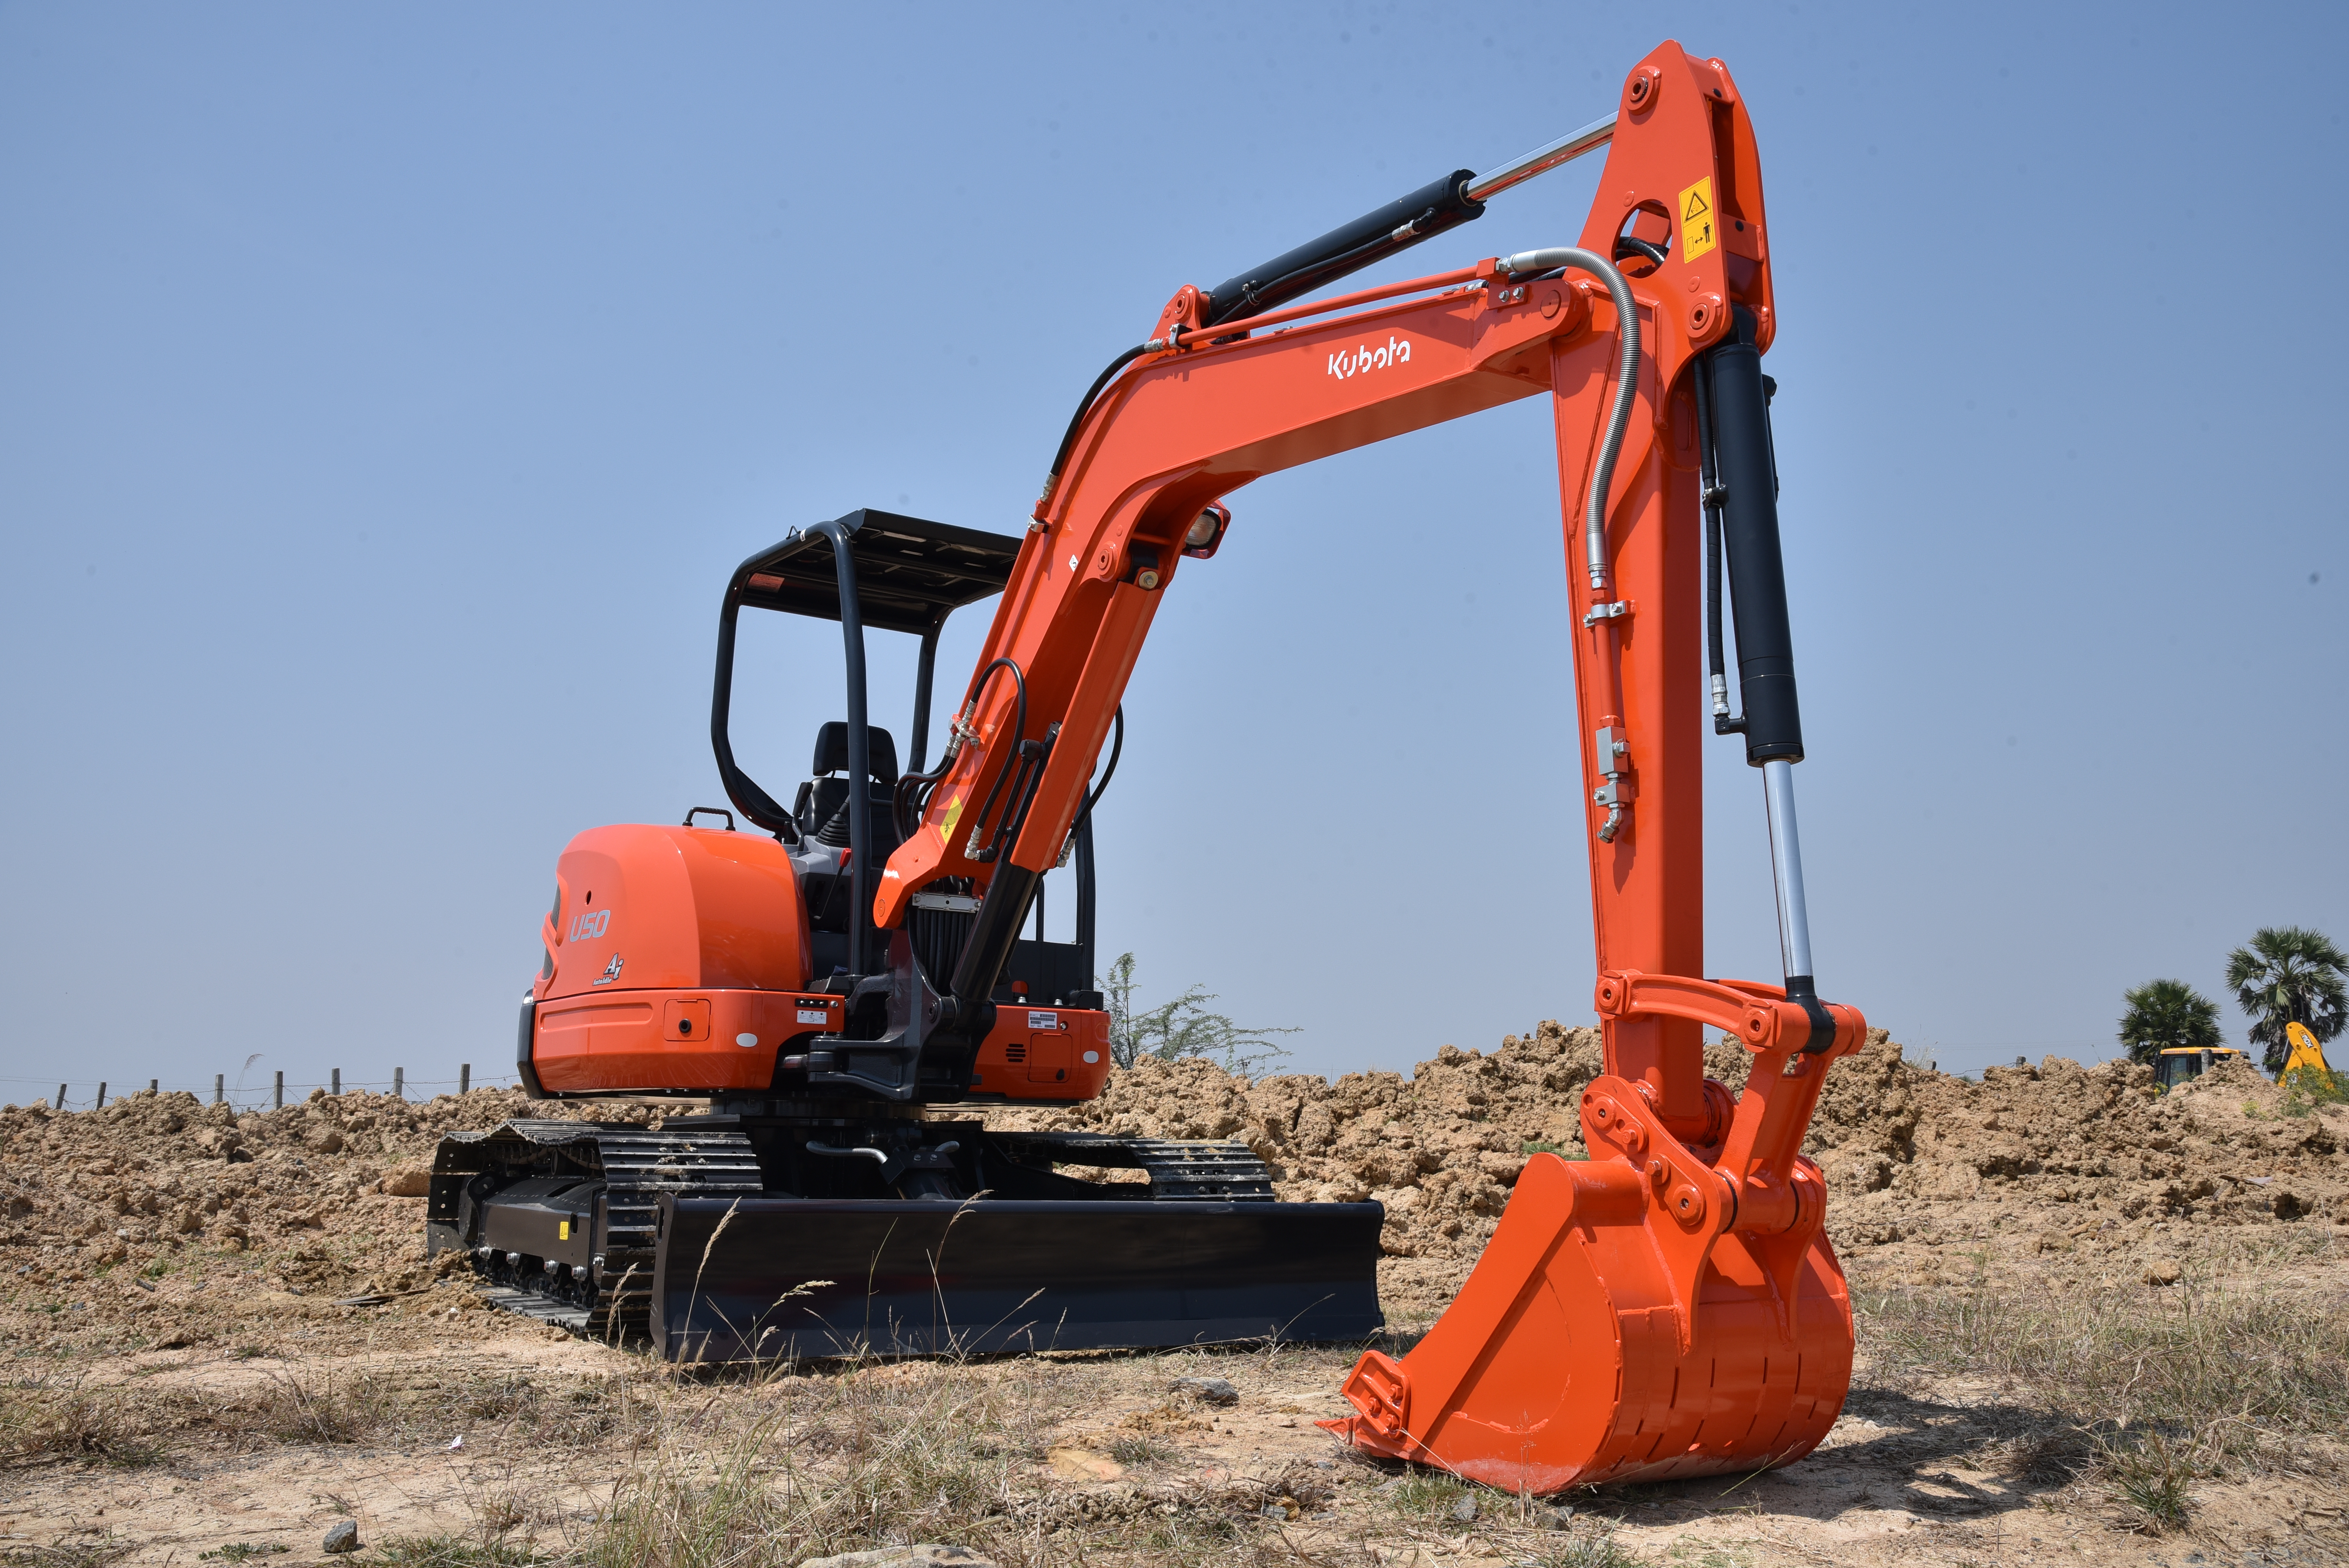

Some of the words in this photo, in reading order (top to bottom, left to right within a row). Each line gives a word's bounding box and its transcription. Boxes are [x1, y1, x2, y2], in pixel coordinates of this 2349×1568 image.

[1328, 336, 1410, 380] Kubota
[570, 909, 611, 942] U50
[604, 952, 624, 980] Ai
[592, 976, 612, 986] AutoIdle
[2302, 1035, 2313, 1048] 3DX
